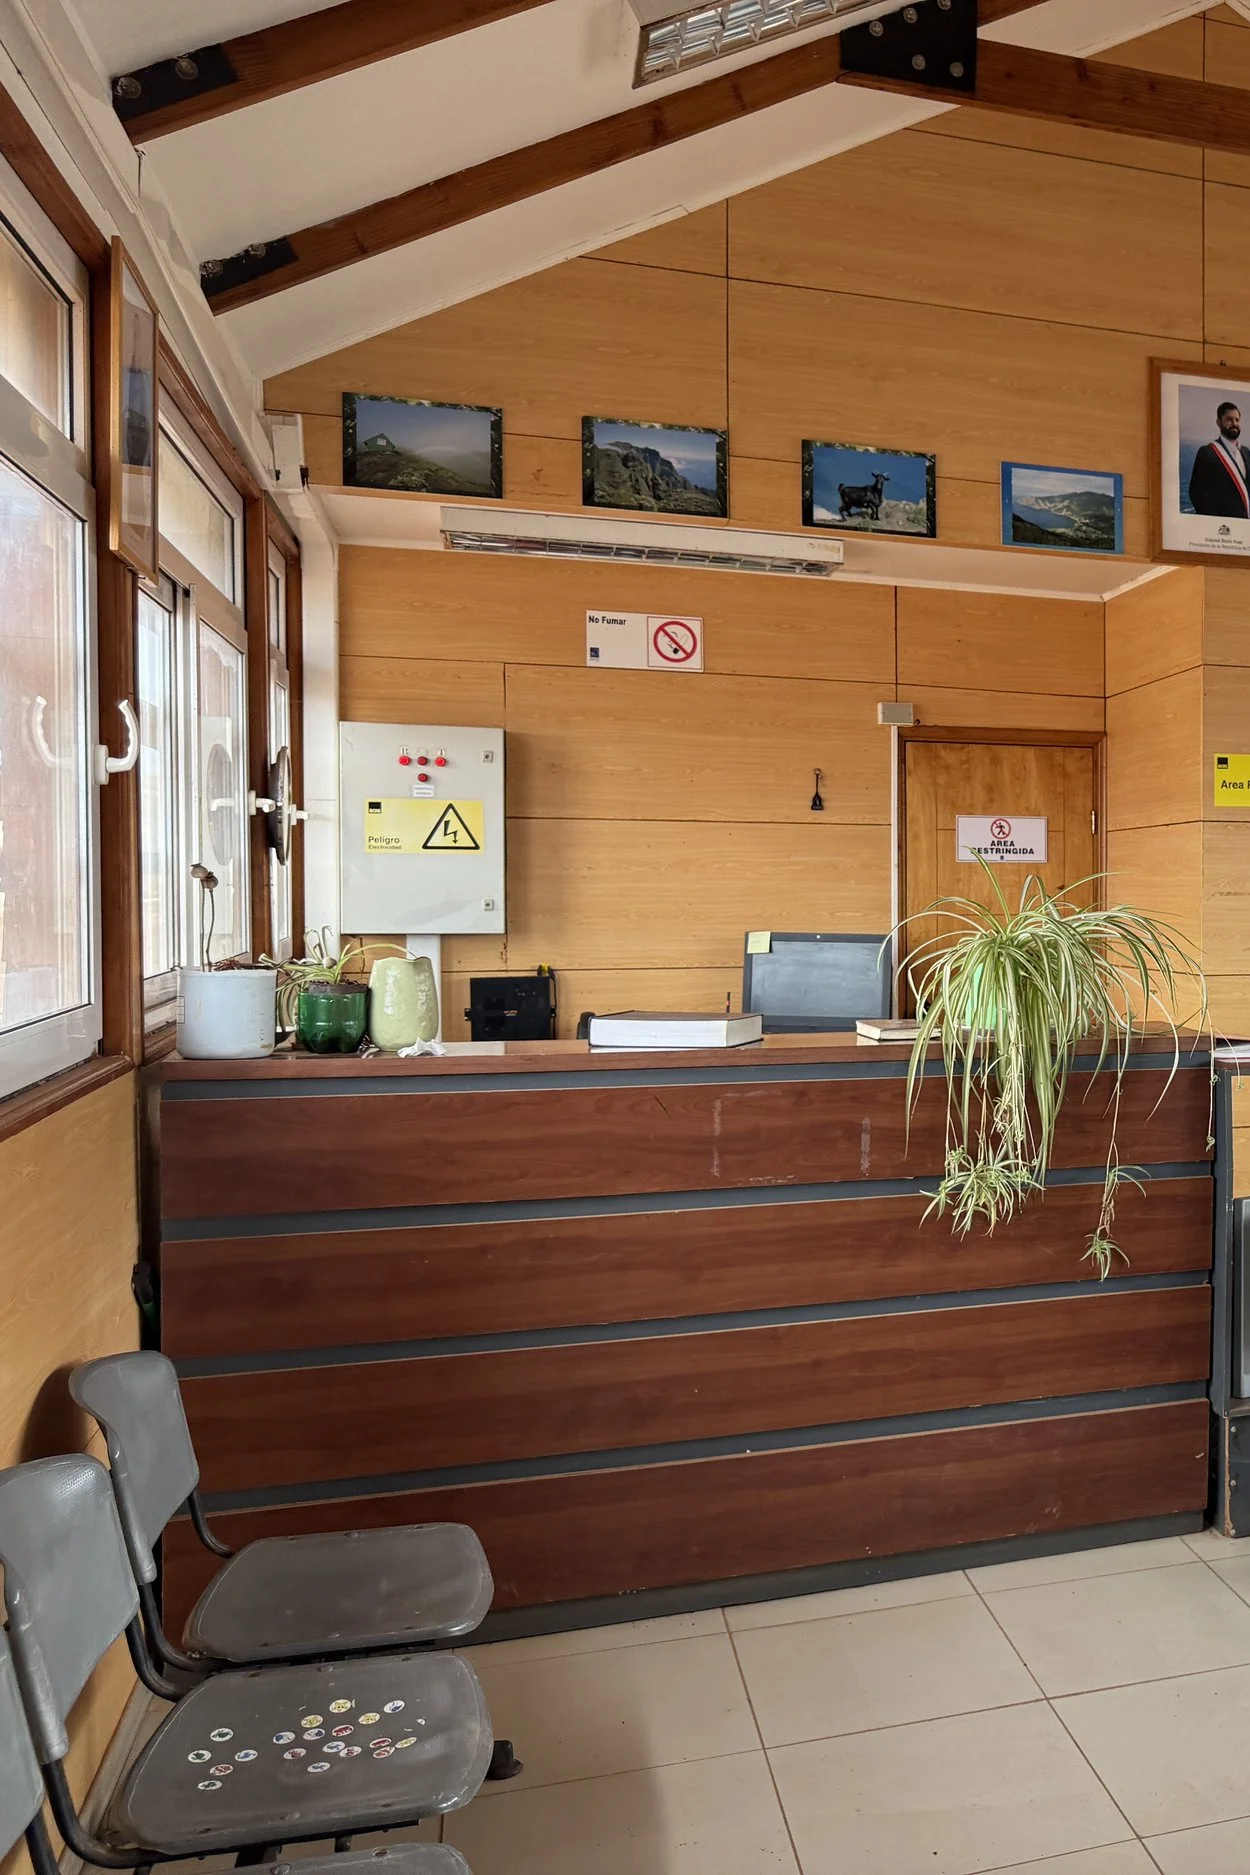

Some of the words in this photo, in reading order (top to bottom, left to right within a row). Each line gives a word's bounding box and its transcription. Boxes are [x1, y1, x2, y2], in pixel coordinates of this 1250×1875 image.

[588, 616, 600, 624] No
[602, 616, 626, 626] Fumar
[1221, 780, 1244, 789] Area
[368, 836, 400, 844] Peligro
